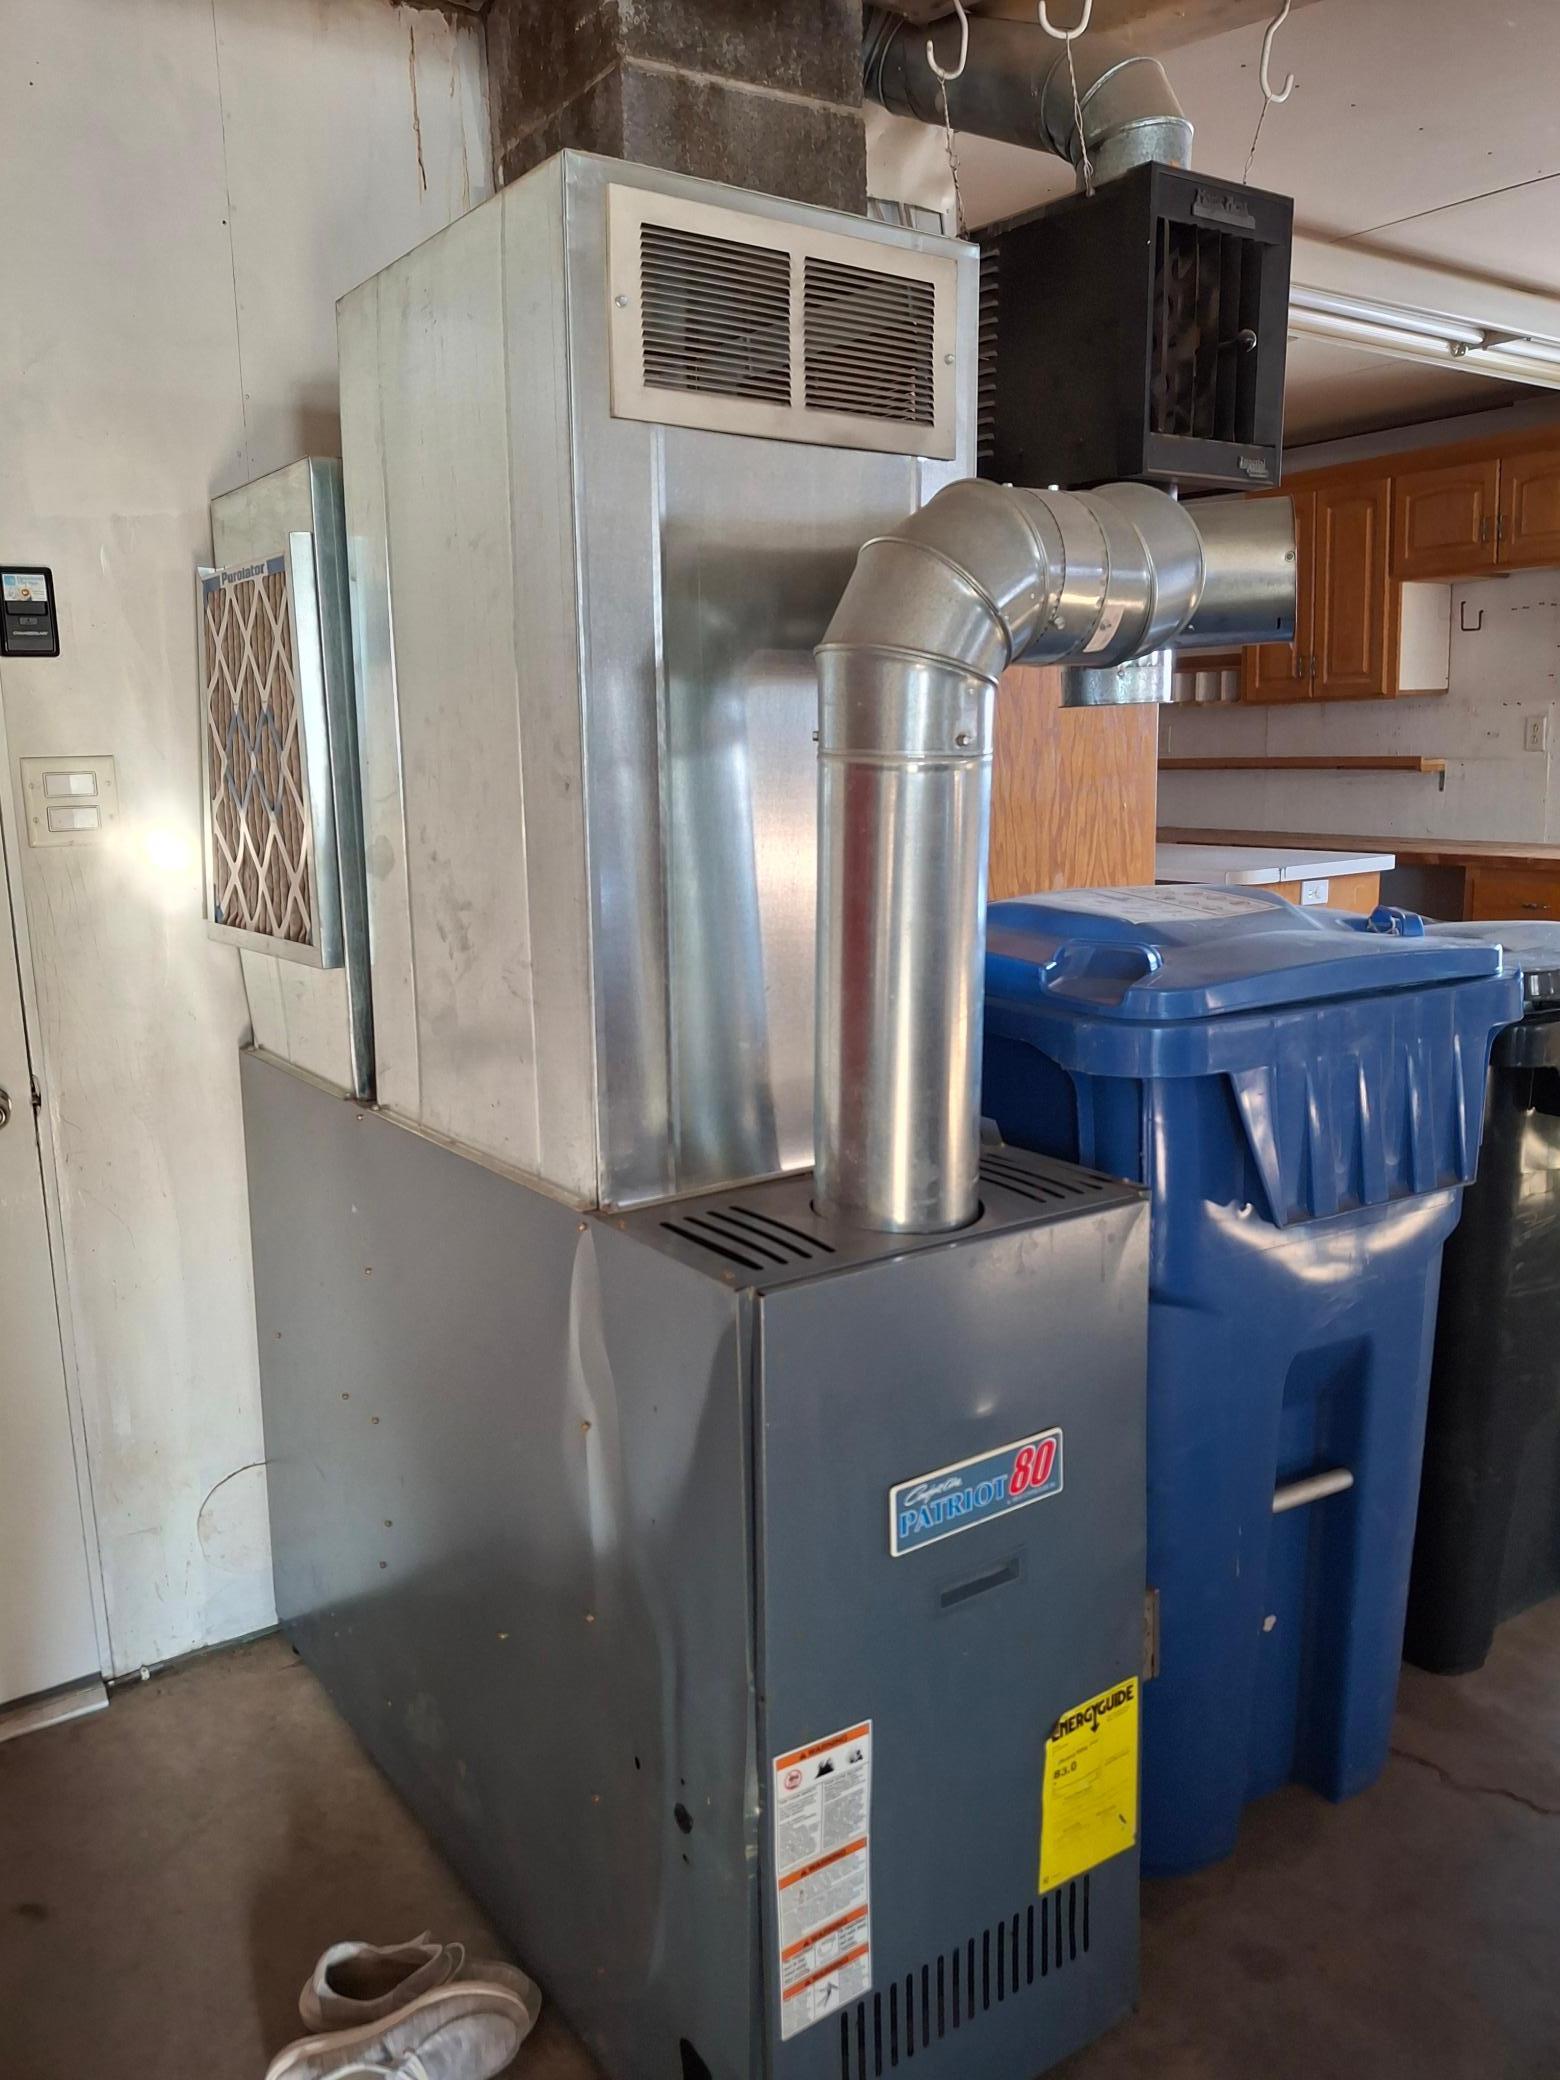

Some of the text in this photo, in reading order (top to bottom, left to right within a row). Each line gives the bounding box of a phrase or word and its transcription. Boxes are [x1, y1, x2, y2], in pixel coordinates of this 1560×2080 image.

[222, 563, 265, 585] Purolator
[899, 1474, 1008, 1538] PATRIOT
[1009, 1437, 1057, 1496] 80
